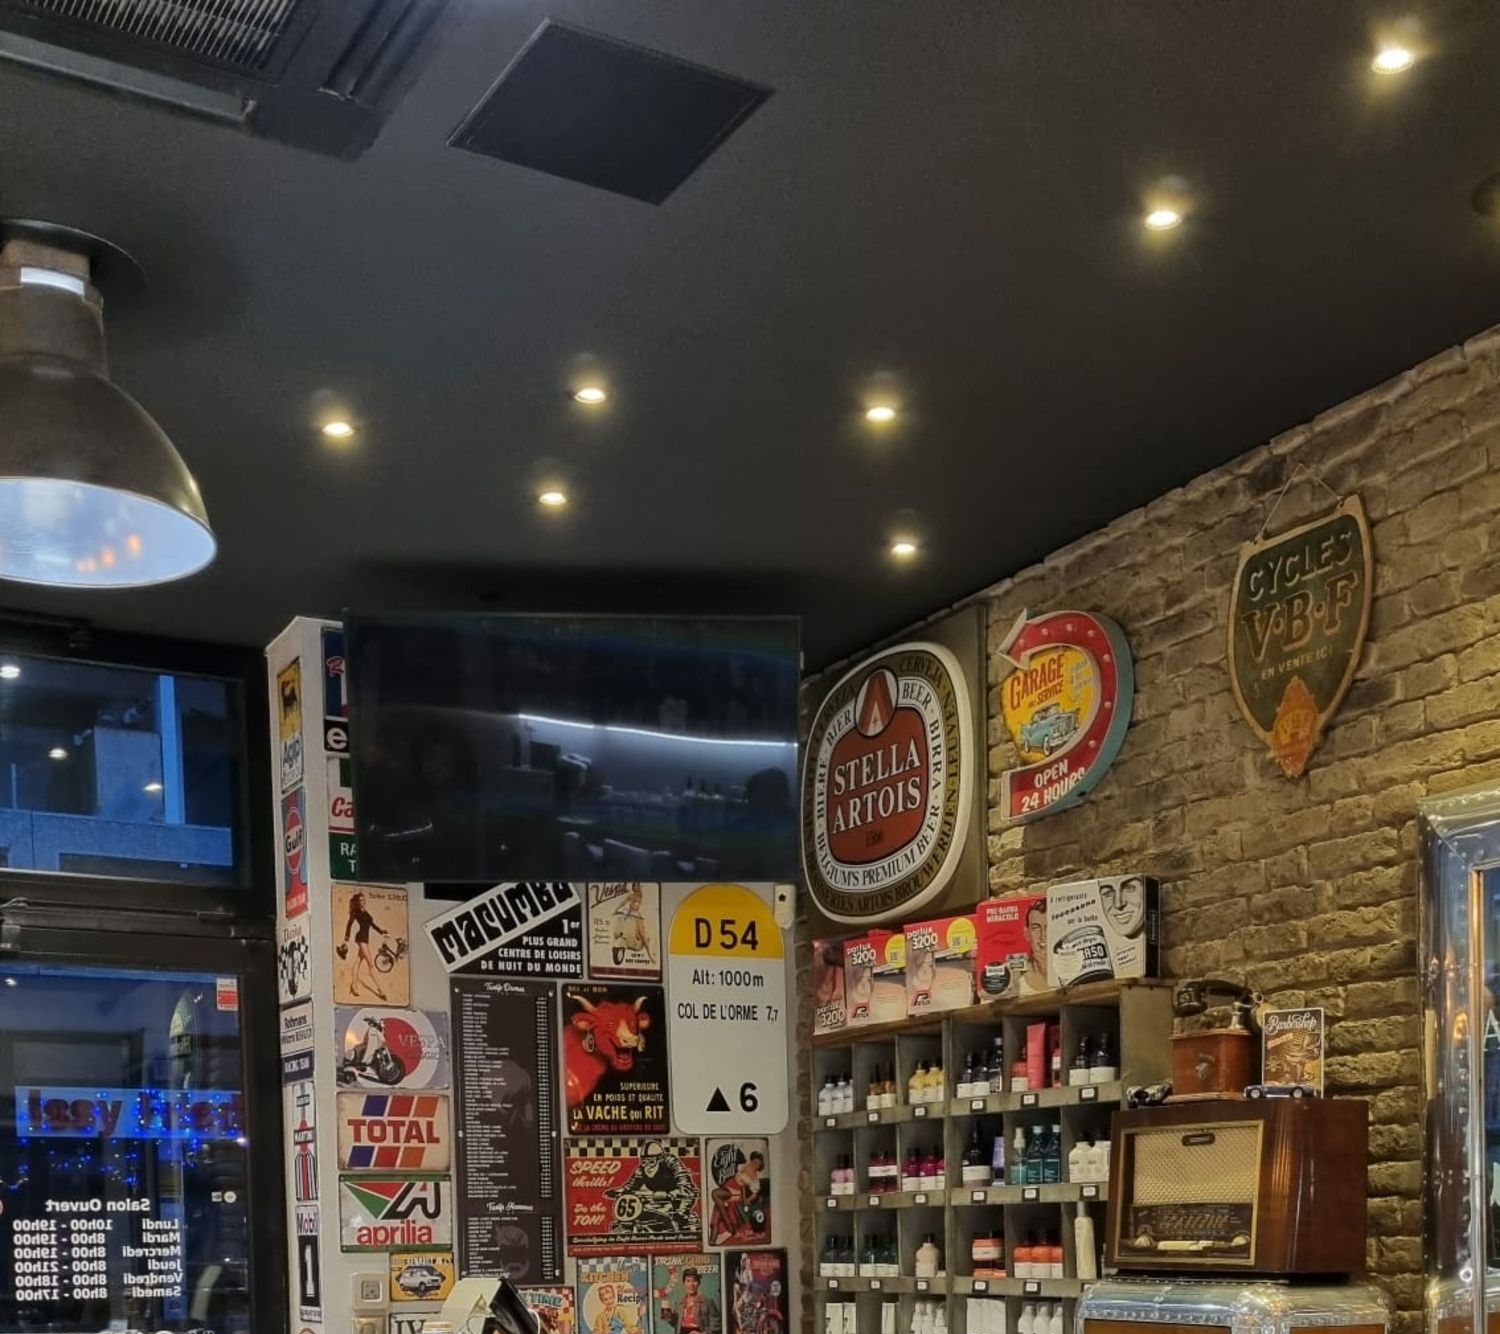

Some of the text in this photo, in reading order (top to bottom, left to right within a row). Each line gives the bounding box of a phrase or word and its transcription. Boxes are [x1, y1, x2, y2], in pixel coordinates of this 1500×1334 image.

[1250, 531, 1352, 601] CYCLES
[1261, 666, 1275, 680] EN
[1278, 655, 1314, 673] VENTE
[1010, 653, 1065, 711] GARAGE
[902, 681, 941, 791] BEER BIRRA
[833, 737, 922, 797] STELLA
[1034, 759, 1068, 788] OPEN
[1021, 766, 1086, 813] 24 HOURS
[832, 776, 922, 835] ARTOIS
[861, 849, 916, 887] PREMIUM
[916, 804, 941, 852] BEER
[522, 936, 578, 948] PLUS GRAND
[912, 933, 939, 950] 3200
[481, 960, 582, 973] DE NUIT DU MONDE
[498, 948, 581, 961] CENTRE DE LOISIRS
[851, 950, 877, 965] 3200
[692, 969, 716, 986] Alt:
[678, 1002, 699, 1020] COL
[703, 1003, 717, 1020] DE
[720, 1004, 759, 1021] L'ORME
[820, 1009, 846, 1027] 3200
[397, 1033, 446, 1050] VESPA
[739, 1082, 759, 1113] 6
[28, 1088, 123, 1138] Issy
[573, 1108, 584, 1120] LA
[586, 1106, 628, 1120] VACHE
[645, 1106, 664, 1120] RIT
[347, 1118, 441, 1144] TOTAL
[569, 1160, 622, 1175] SPEED
[616, 1196, 637, 1218] 65
[356, 1219, 433, 1248] aprilia
